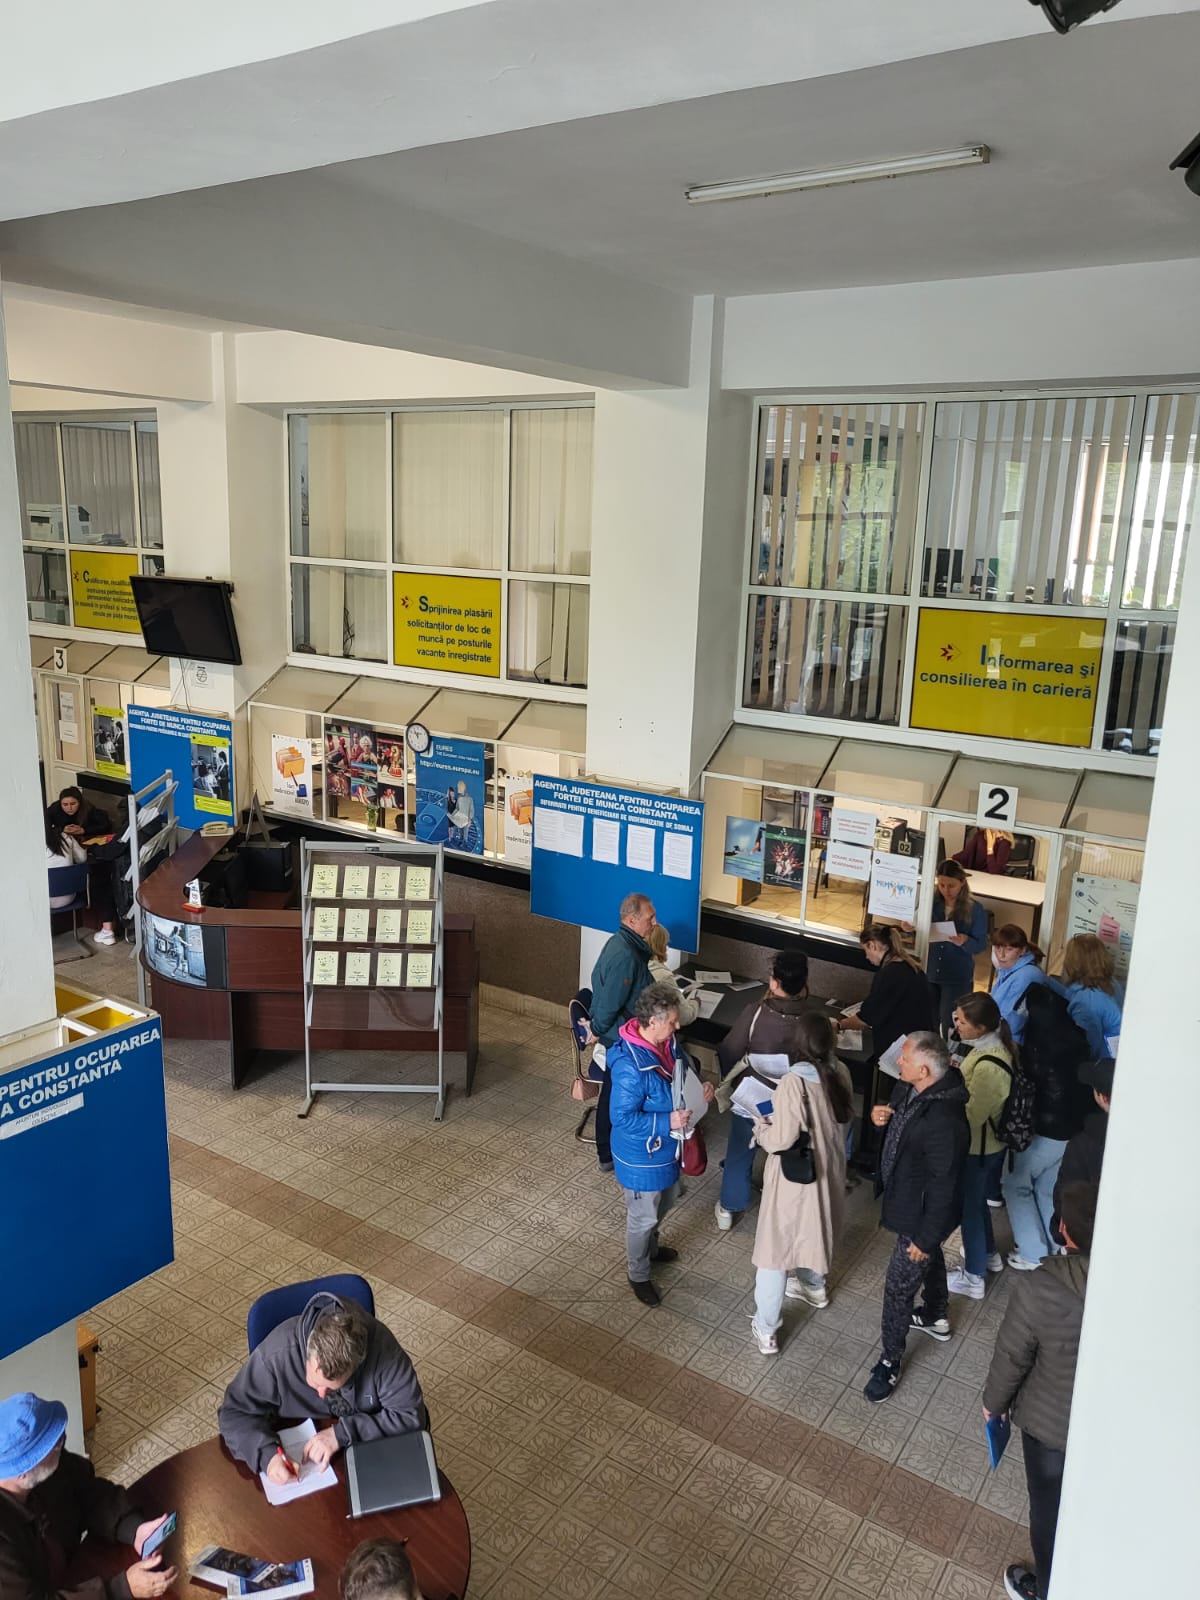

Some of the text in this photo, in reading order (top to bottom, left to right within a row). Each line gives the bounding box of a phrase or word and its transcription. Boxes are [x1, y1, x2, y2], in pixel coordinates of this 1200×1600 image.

[418, 595, 462, 616] Sprijinirea
[455, 623, 465, 632] de
[466, 624, 479, 634] loc
[481, 625, 491, 635] de
[416, 648, 446, 658] vacante
[418, 634, 492, 649] muncă pe posturile
[55, 649, 65, 670] 3
[980, 644, 1074, 675] Informarea
[919, 671, 1092, 699] consilierea în carieră
[166, 722, 185, 731] MUNCA
[185, 725, 217, 737] CONSTANTA
[180, 717, 202, 727] PENTRU
[202, 720, 231, 732] OCUPAREA
[534, 779, 701, 816] AGENTIA JUDETEANA PENTRU OCUPAREA
[553, 791, 678, 821] FORTEI DE MUNCA CONSTANTA
[984, 787, 1009, 821] 2
[567, 803, 587, 813] PENTRU
[620, 812, 627, 820] DE
[665, 822, 673, 830] DE
[899, 842, 910, 853] 02
[0, 1028, 161, 1100] PENTRU OCUPAREA
[18, 1059, 122, 1110] CONSTANTA
